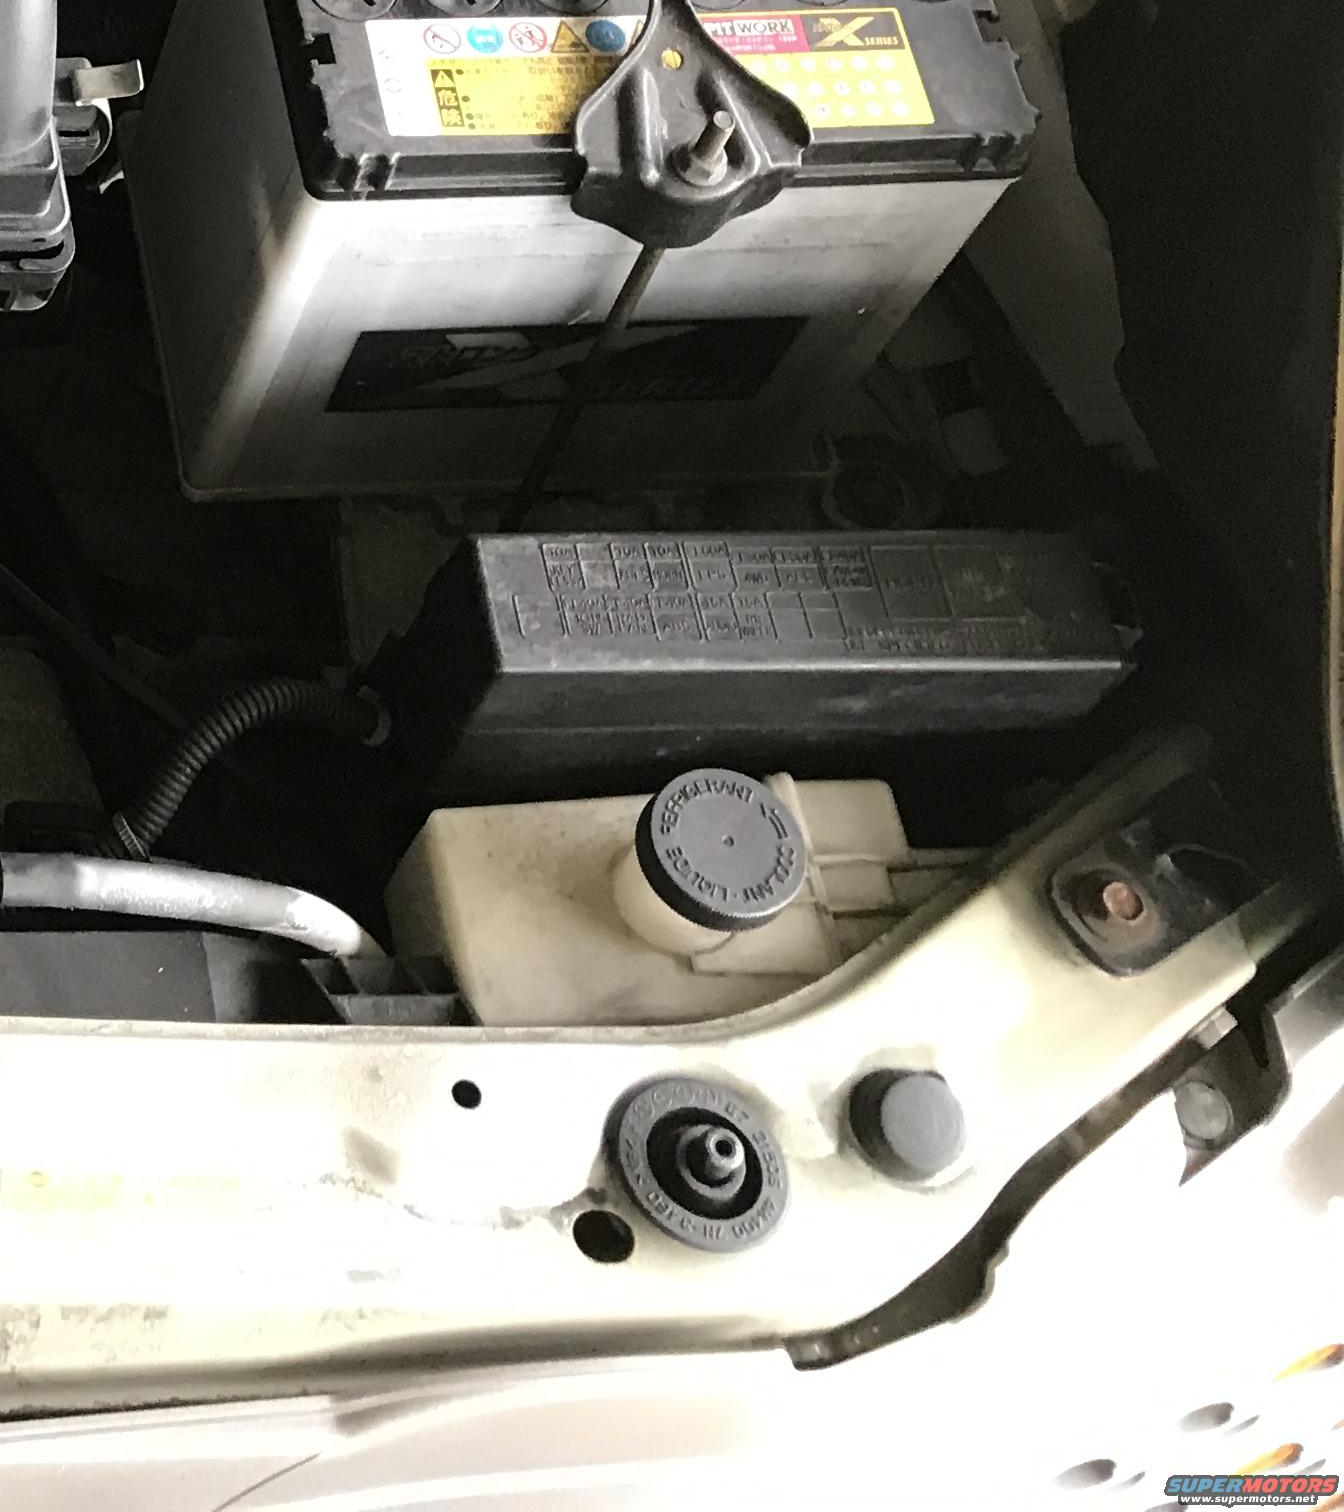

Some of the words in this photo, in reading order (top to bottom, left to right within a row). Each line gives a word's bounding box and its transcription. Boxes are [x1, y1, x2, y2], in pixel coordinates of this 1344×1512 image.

[736, 19, 793, 34] WORK
[864, 36, 899, 47] SERIES
[438, 89, 463, 126] 危険
